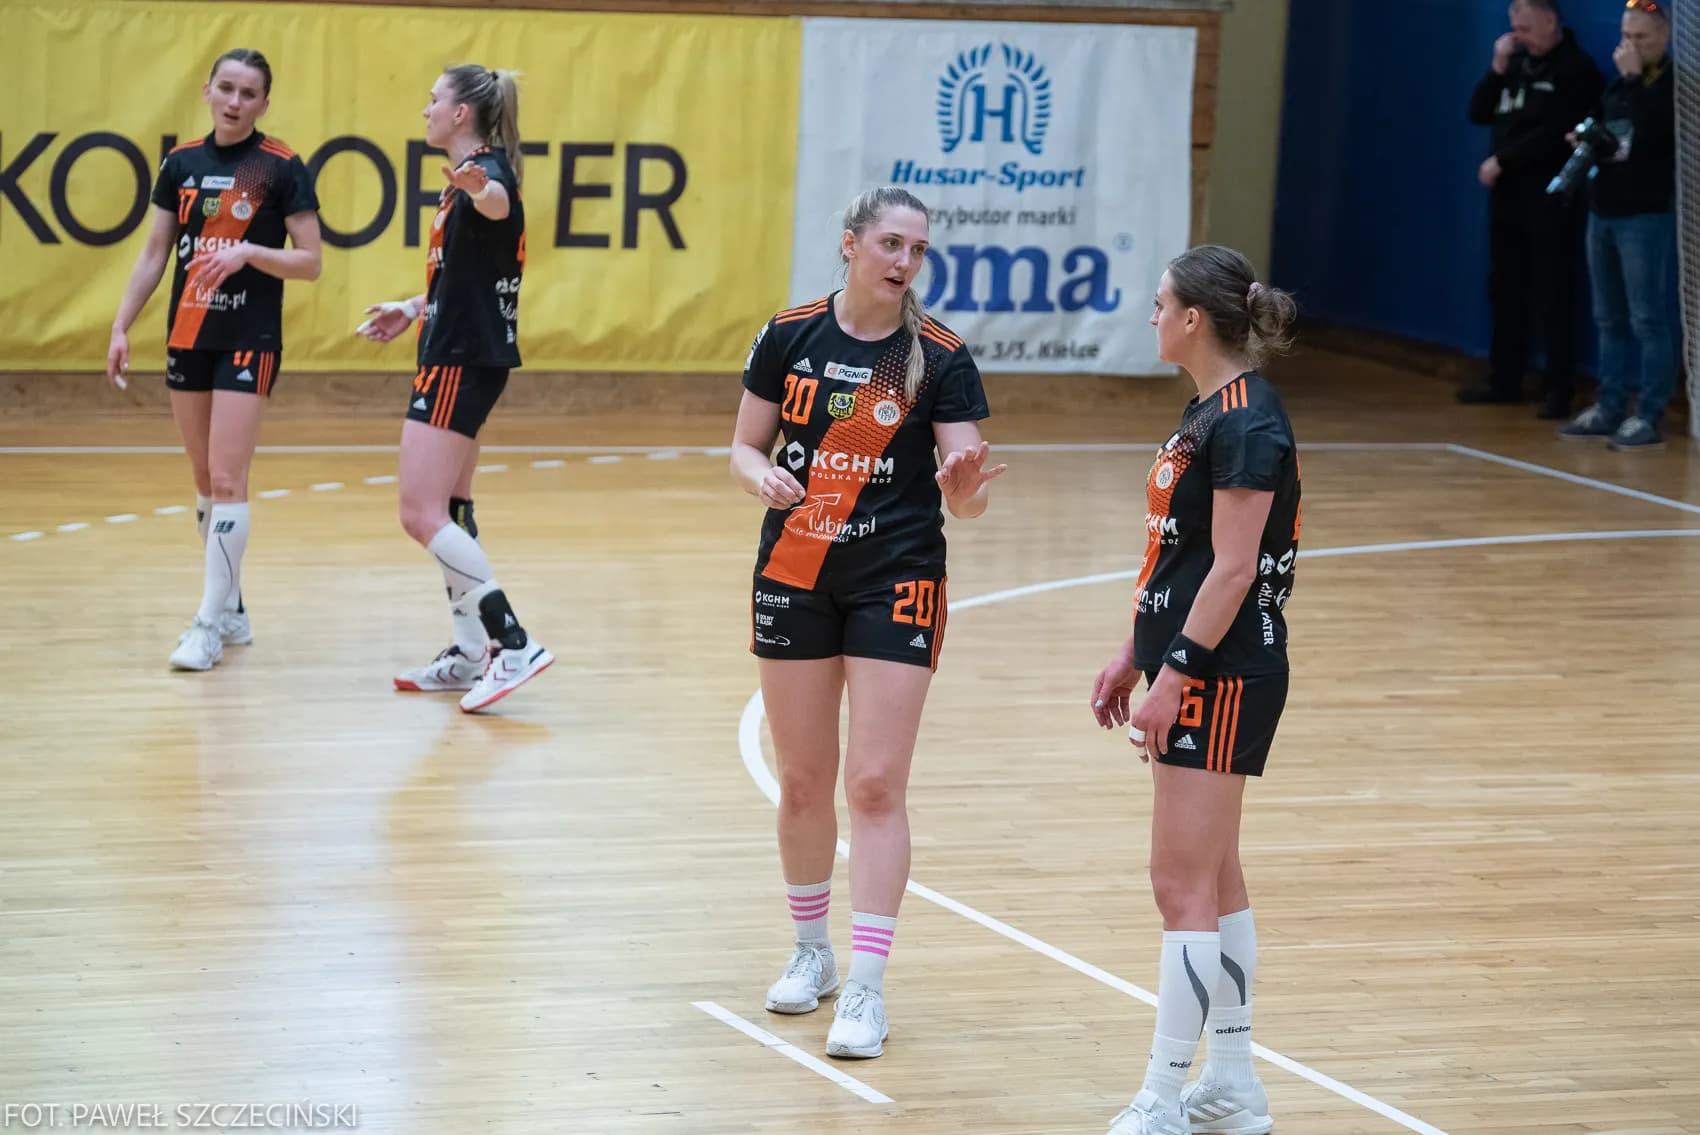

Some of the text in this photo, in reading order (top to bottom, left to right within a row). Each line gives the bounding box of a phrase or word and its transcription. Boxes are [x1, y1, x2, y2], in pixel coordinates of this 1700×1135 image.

[890, 159, 1085, 192] Husar-Sport
[1017, 206, 1076, 226] marki
[838, 368, 869, 379] PGNiG
[781, 374, 819, 425] 20
[811, 449, 894, 475] KGHM
[810, 471, 851, 481] POLSKA
[808, 514, 876, 538] lubin.pl
[762, 593, 790, 605] KGHM
[892, 580, 935, 627] 20
